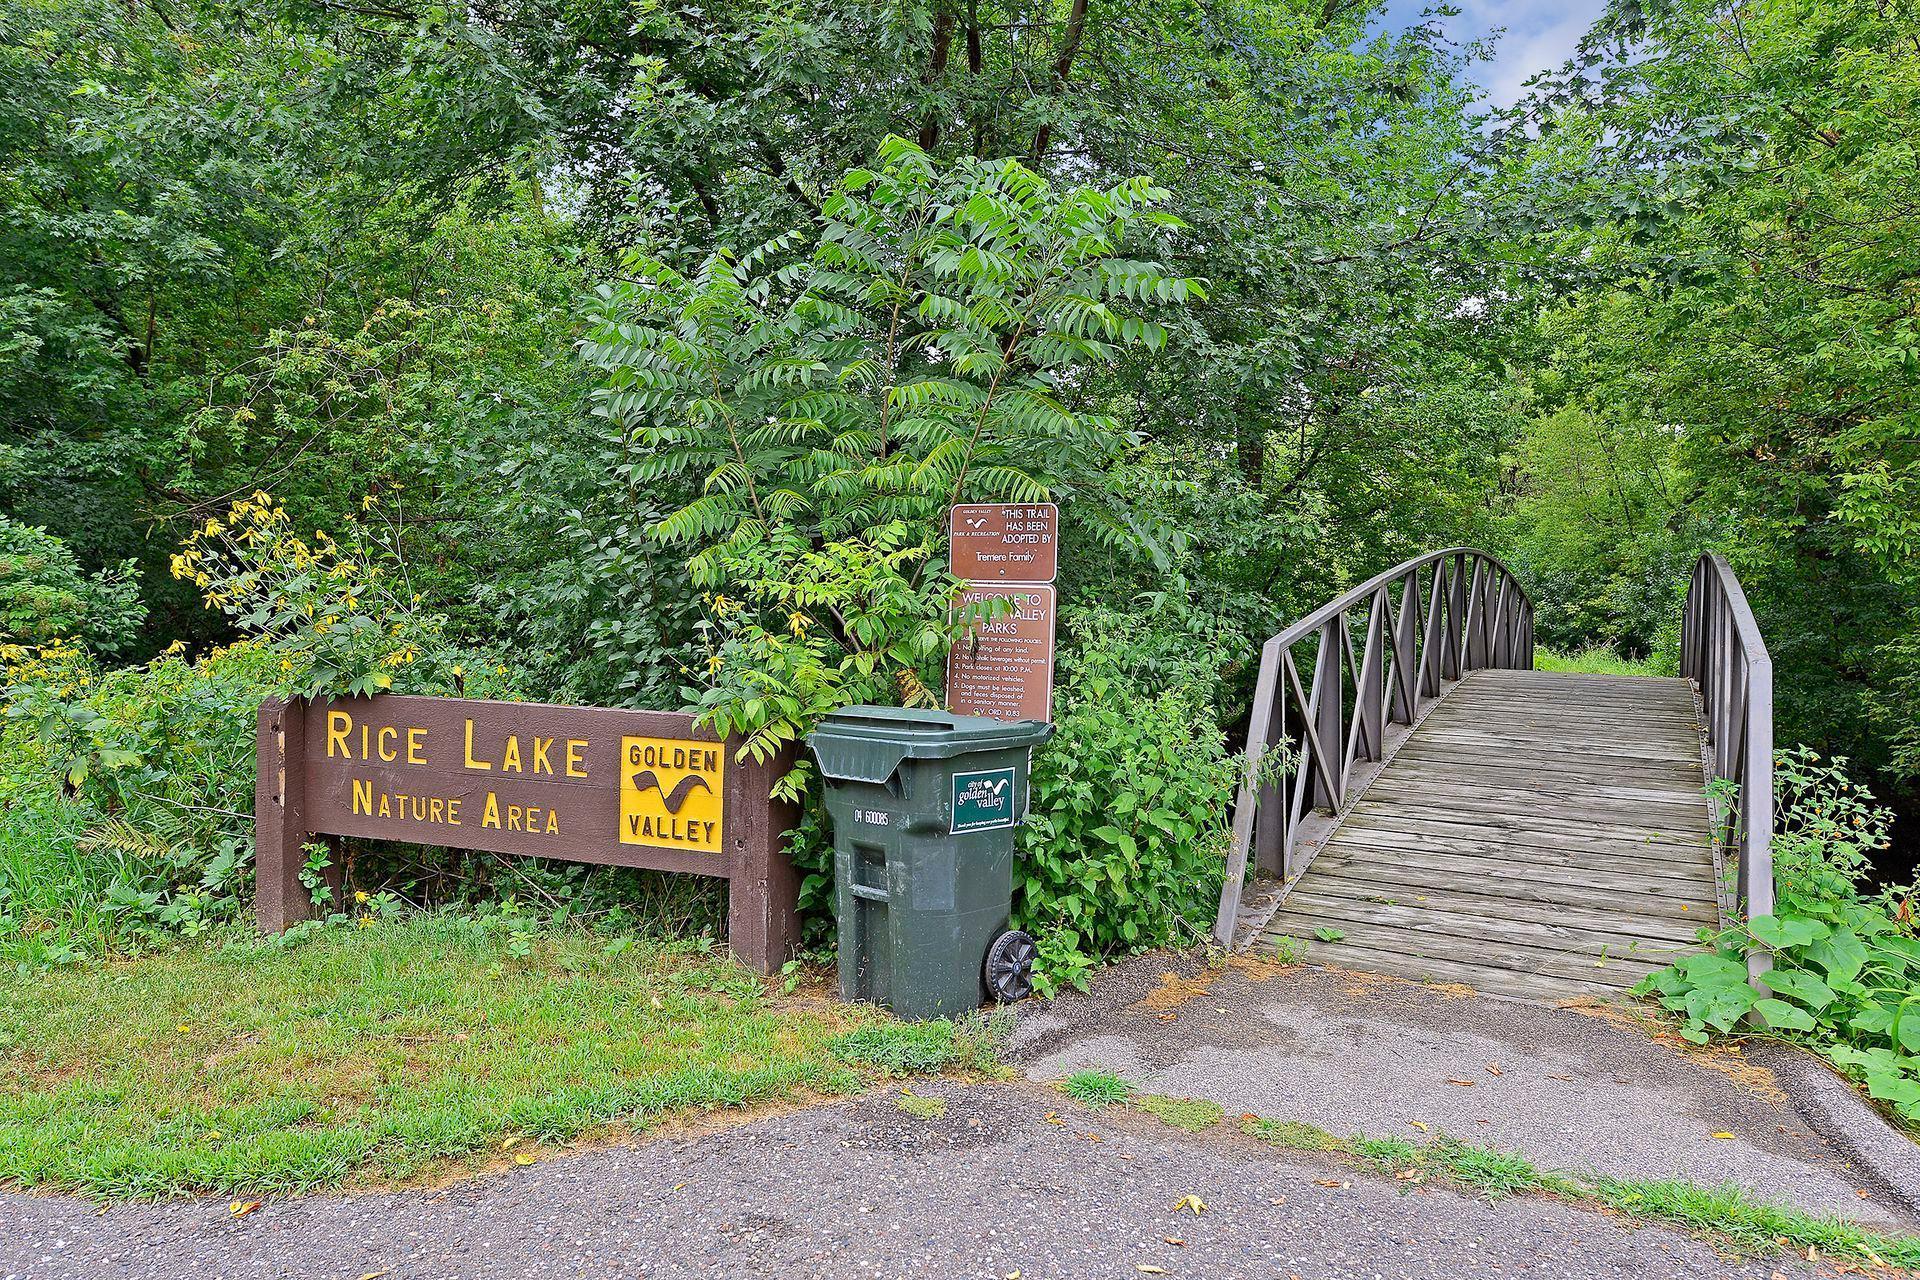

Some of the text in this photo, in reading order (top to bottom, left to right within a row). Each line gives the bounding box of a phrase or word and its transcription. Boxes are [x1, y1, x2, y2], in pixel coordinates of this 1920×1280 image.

[1006, 509, 1050, 518] THIS TRAIL
[1006, 522, 1048, 531] HAS BEEN
[1002, 534, 1052, 544] ADOPTED BY
[976, 550, 1035, 564] Tremere Family
[1026, 594, 1041, 606] TO
[982, 622, 1018, 635] PARKS
[326, 710, 590, 778] RICE LAKE
[629, 744, 718, 772] GOLDEN
[958, 788, 987, 806] golden
[976, 792, 1005, 811] valley
[352, 778, 560, 835] NATURE AREA
[628, 814, 716, 844] VALLEY
